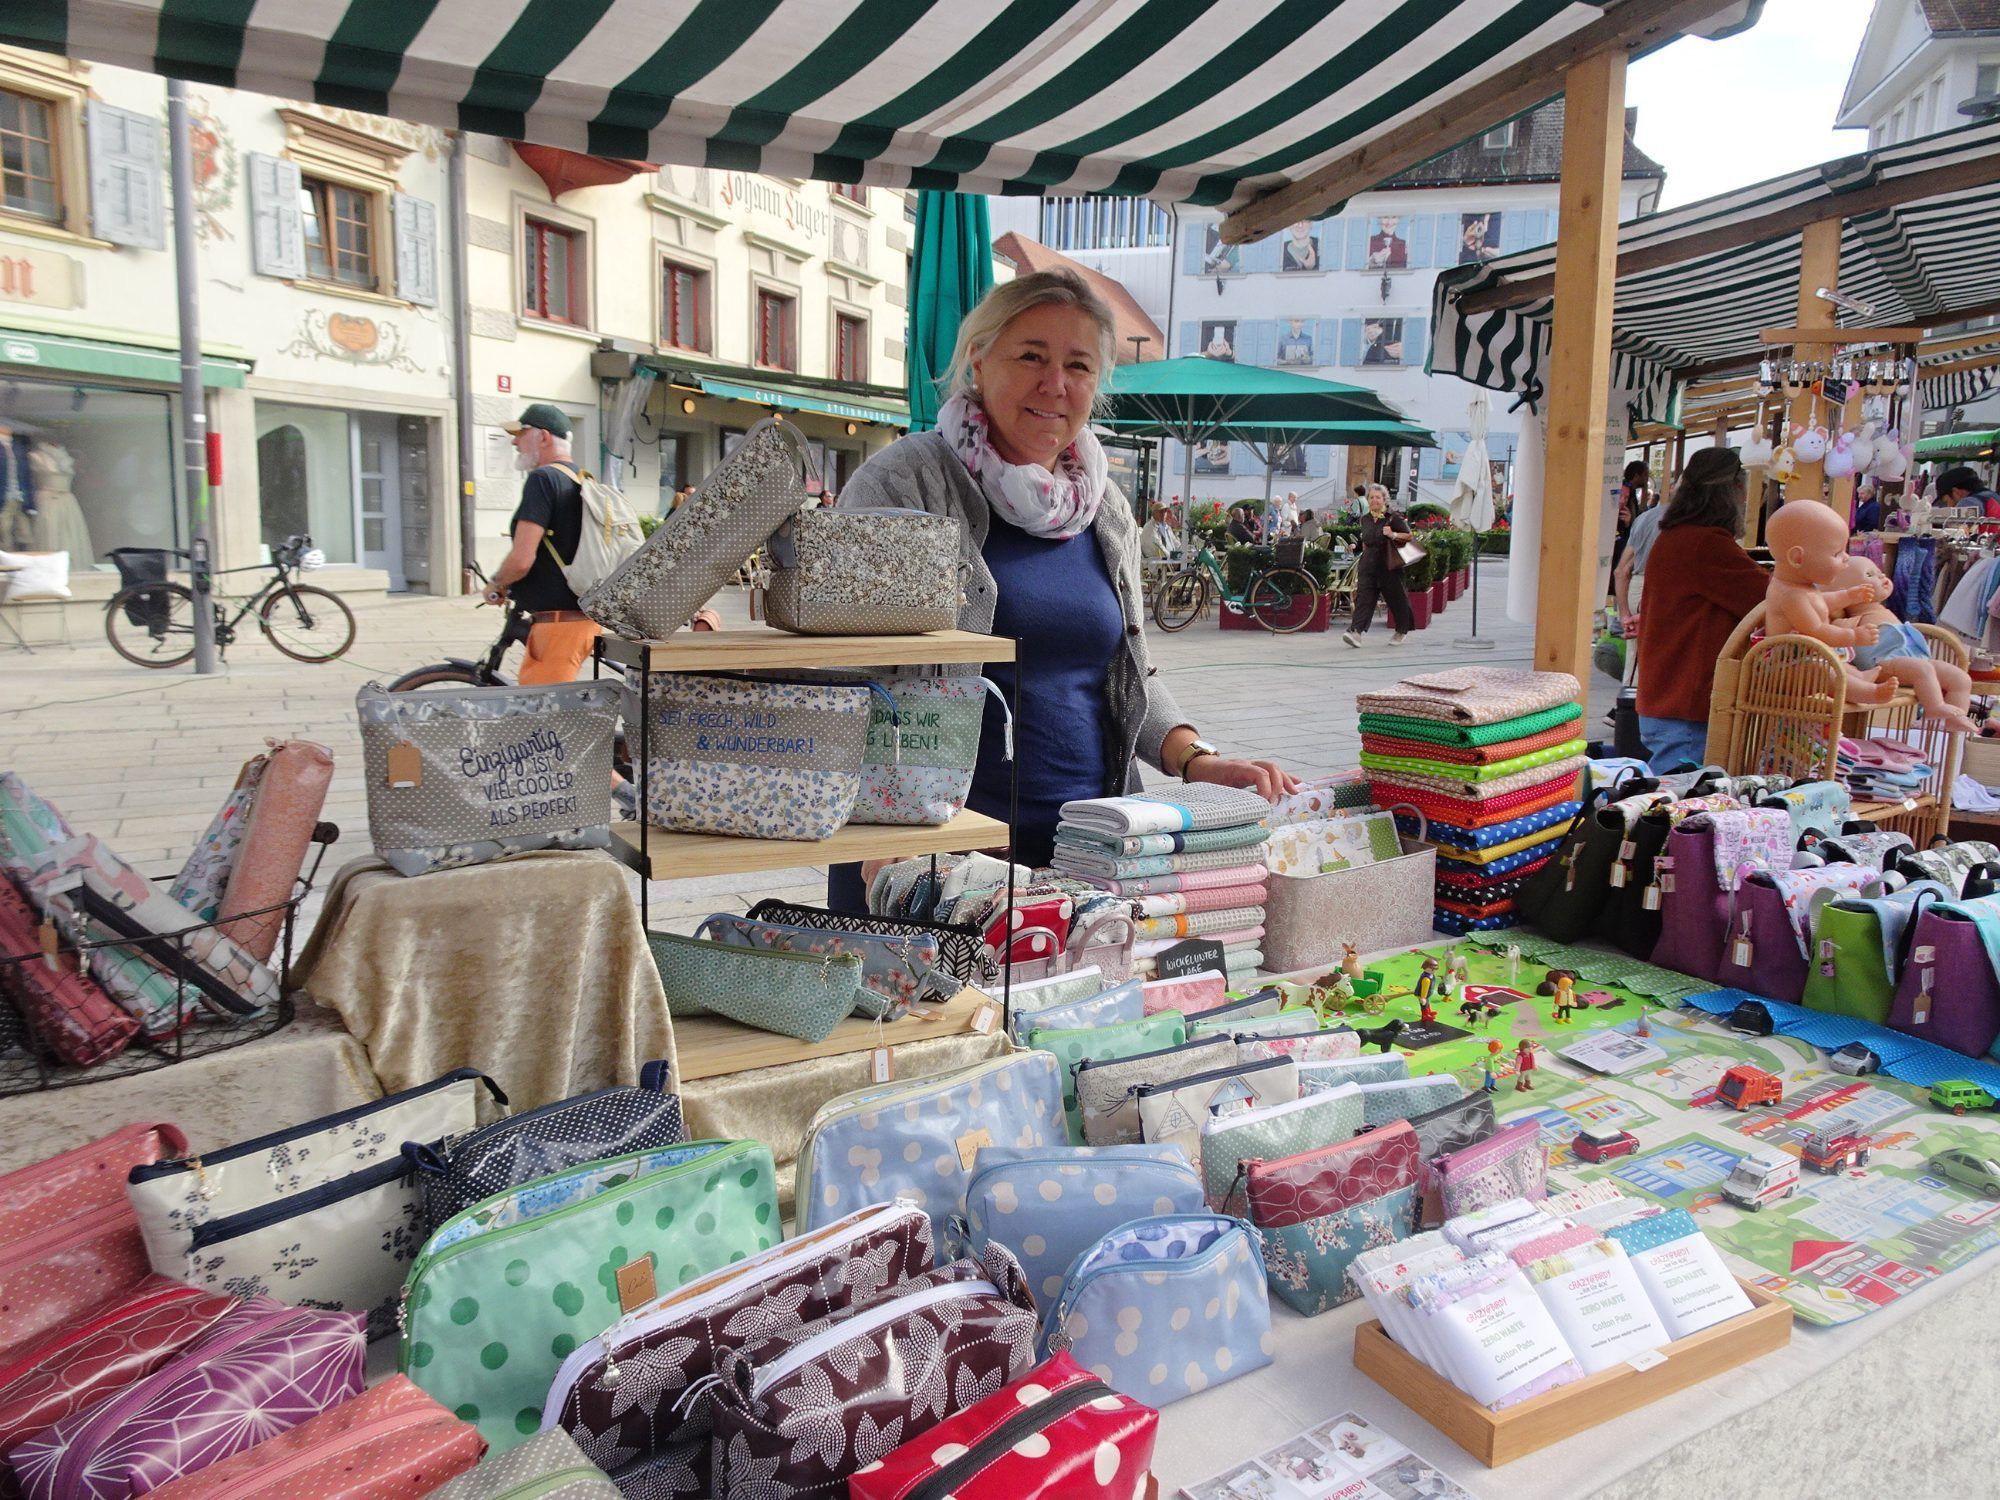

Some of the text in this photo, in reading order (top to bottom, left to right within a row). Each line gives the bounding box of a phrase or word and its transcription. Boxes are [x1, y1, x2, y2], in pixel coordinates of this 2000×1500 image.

[826, 402, 892, 423] STEINHAUSER
[659, 710, 777, 731] SEI FRECH, WILD
[916, 711, 940, 728] WIR
[696, 734, 815, 754] & WUNDERBAR!
[459, 728, 565, 784] Einzigartig
[531, 755, 553, 775] IST
[482, 772, 574, 802] VIEL COOLER
[489, 795, 578, 827] ALS PERFEKT
[1579, 1292, 1626, 1316] ZERO WASTE
[1480, 1332, 1502, 1349] ZERO
[1499, 1319, 1527, 1338] WASTE
[1592, 1318, 1616, 1333] Cotton
[1494, 1347, 1518, 1364] Cotton
